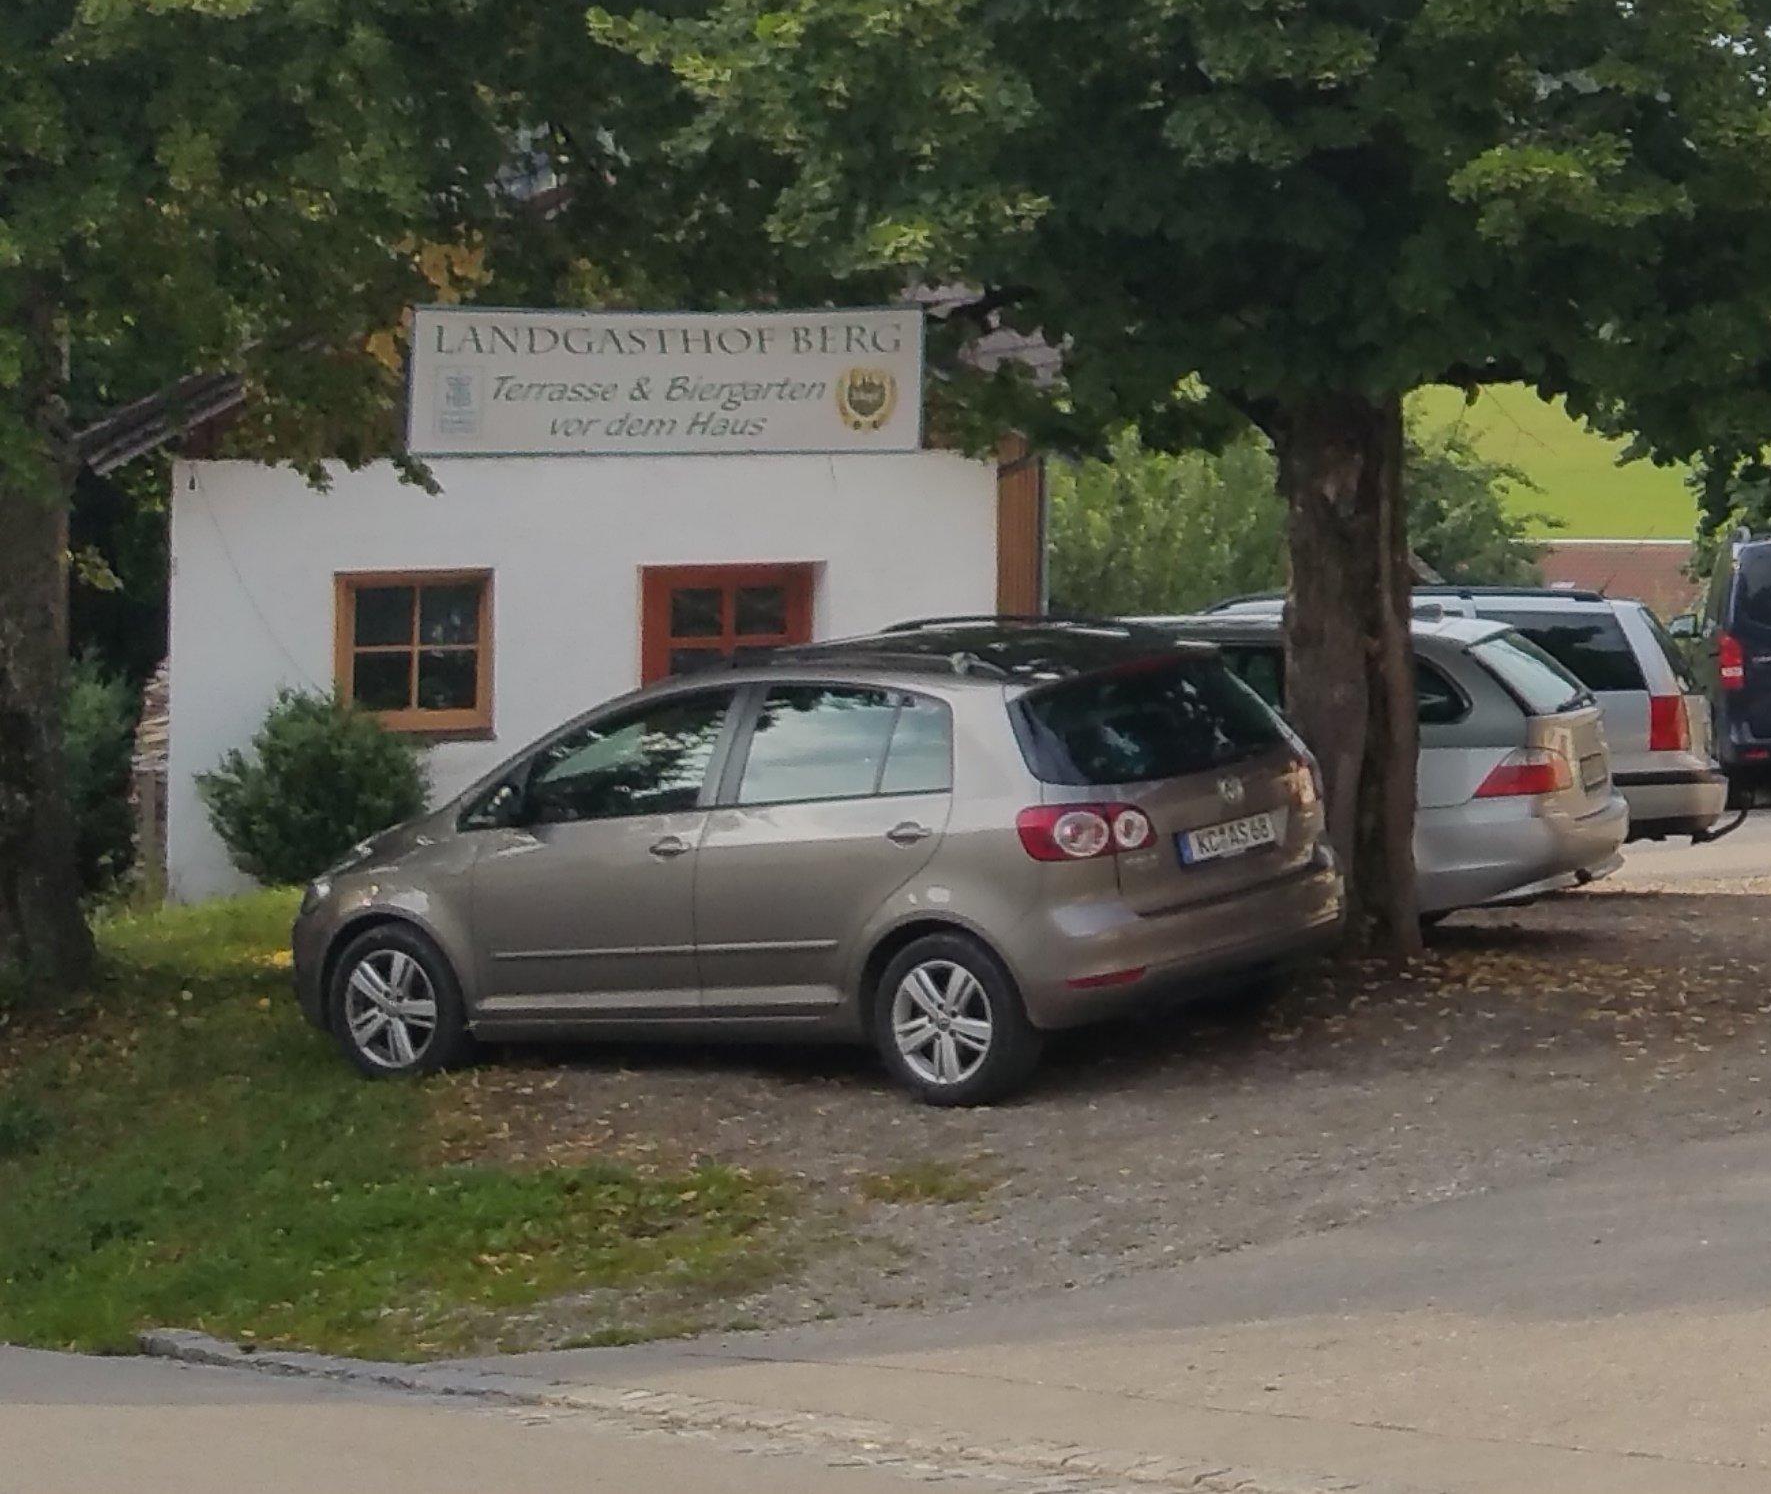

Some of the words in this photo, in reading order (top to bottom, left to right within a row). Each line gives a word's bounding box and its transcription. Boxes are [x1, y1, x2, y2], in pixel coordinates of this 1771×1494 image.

[434, 323, 780, 355] LANDGASTHOF
[792, 324, 901, 354] BERG
[492, 375, 618, 402] Terrasse
[629, 376, 652, 402] &
[665, 374, 828, 412] Biergarten
[549, 417, 593, 438] vor
[605, 411, 677, 437] dem
[686, 412, 768, 436] Haus
